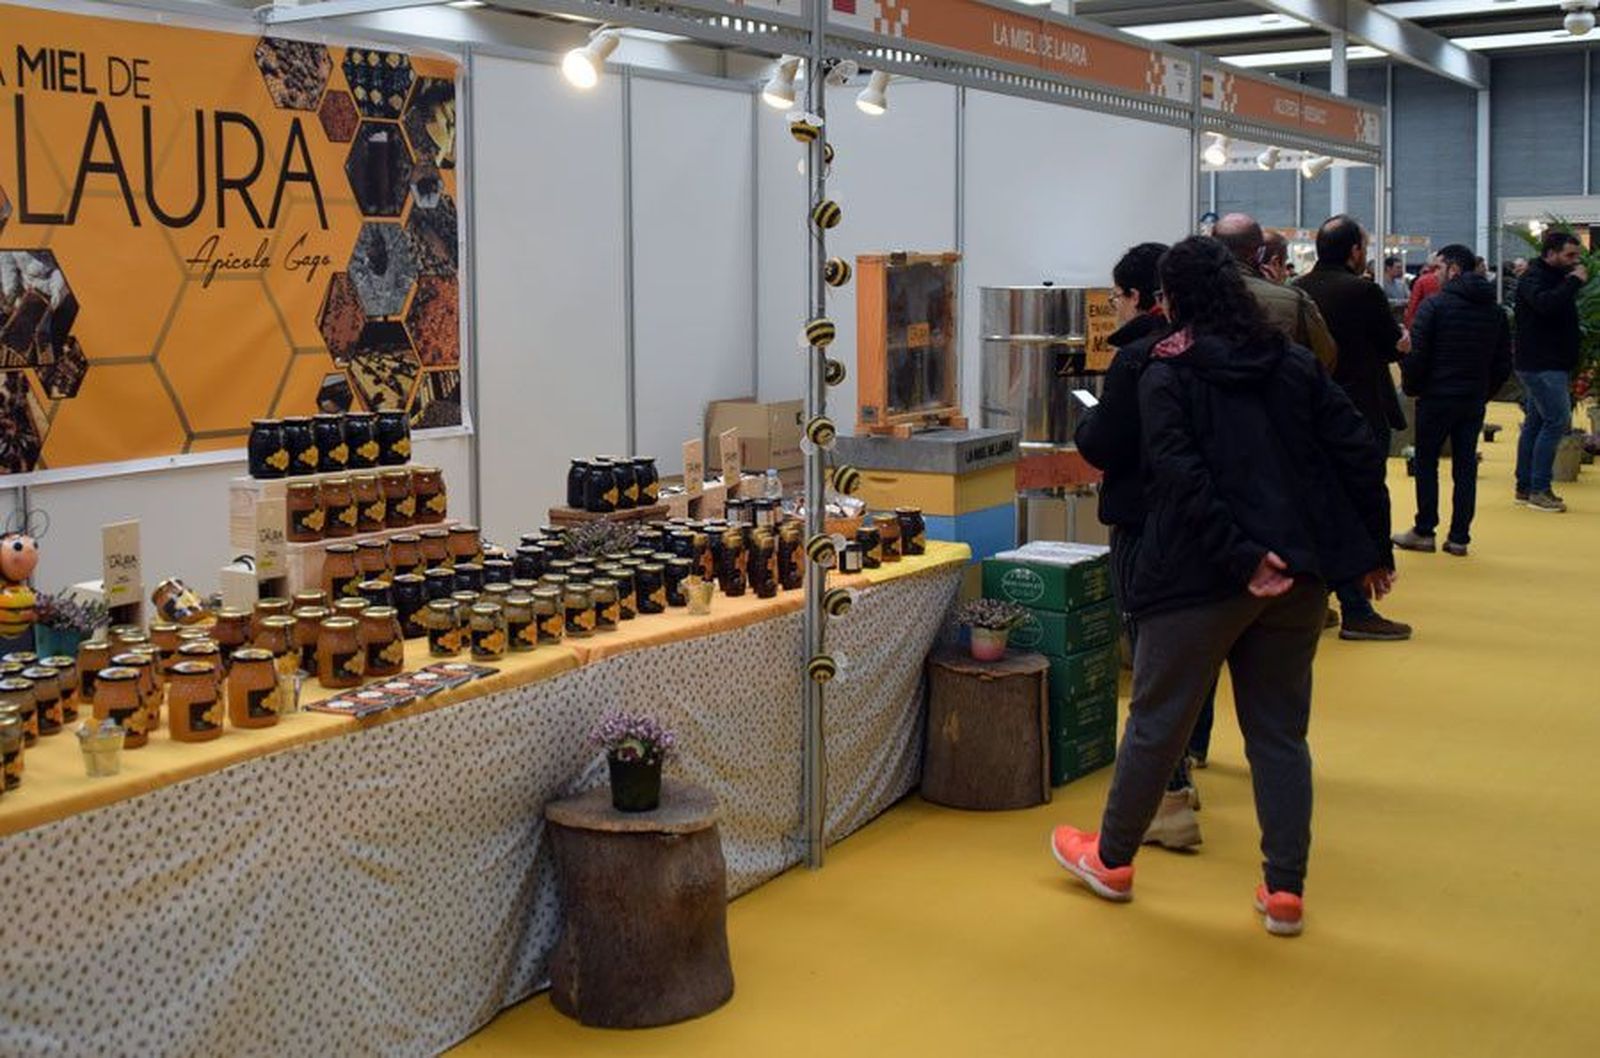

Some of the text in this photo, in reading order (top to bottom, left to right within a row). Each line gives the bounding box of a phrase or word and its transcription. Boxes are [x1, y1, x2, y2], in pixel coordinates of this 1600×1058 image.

[16, 44, 97, 95] MIEL
[107, 56, 151, 99] DE
[993, 20, 1009, 48] LA
[1010, 26, 1037, 54] MIEL
[1054, 37, 1088, 67] LAURA
[13, 93, 330, 231] LAURA
[185, 231, 332, 289] Apicola Gago
